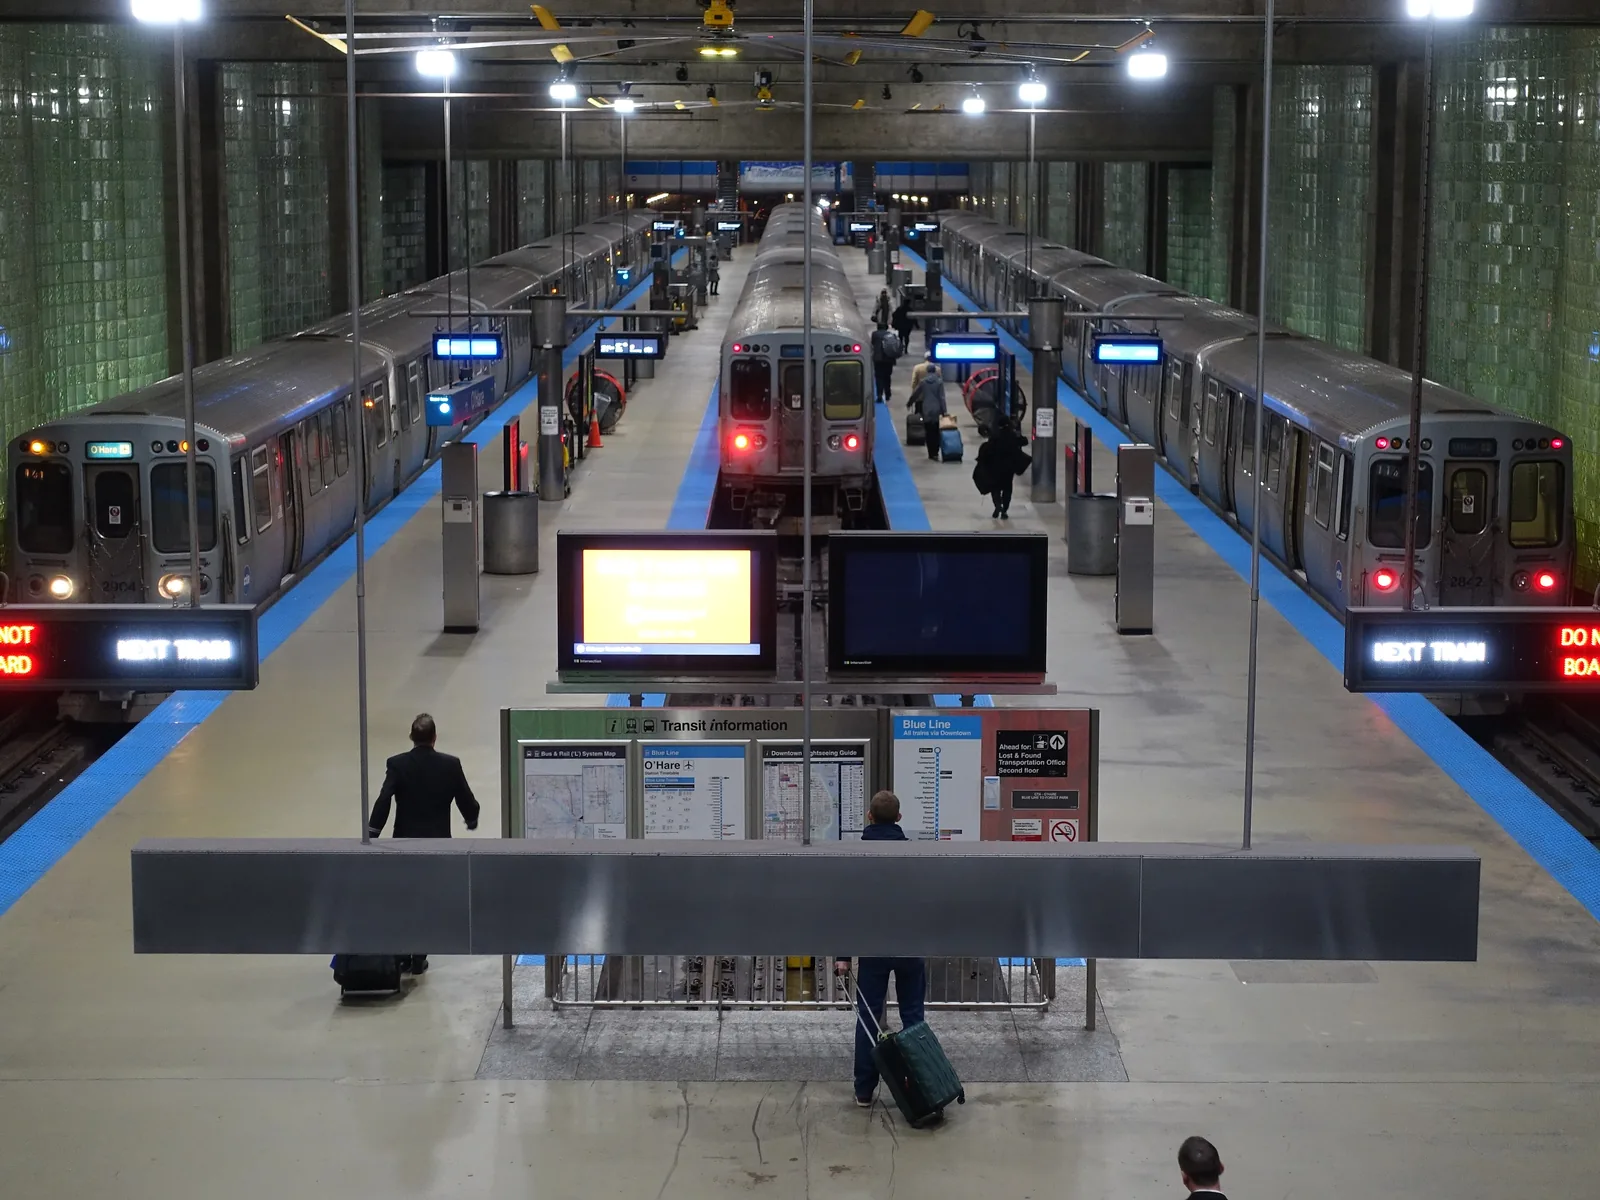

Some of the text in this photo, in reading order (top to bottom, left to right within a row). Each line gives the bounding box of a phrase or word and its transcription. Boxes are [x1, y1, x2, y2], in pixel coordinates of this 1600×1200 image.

[90, 446, 118, 454] O'Hare
[102, 580, 136, 592] 2904
[0, 626, 35, 644] NOT
[1561, 628, 1588, 646] DO
[1374, 642, 1486, 662] NEXT TRAIN
[1564, 658, 1600, 676] BOA
[661, 718, 788, 731] Transit information
[903, 720, 950, 728] Blue Line
[644, 761, 680, 770] O'Hare
